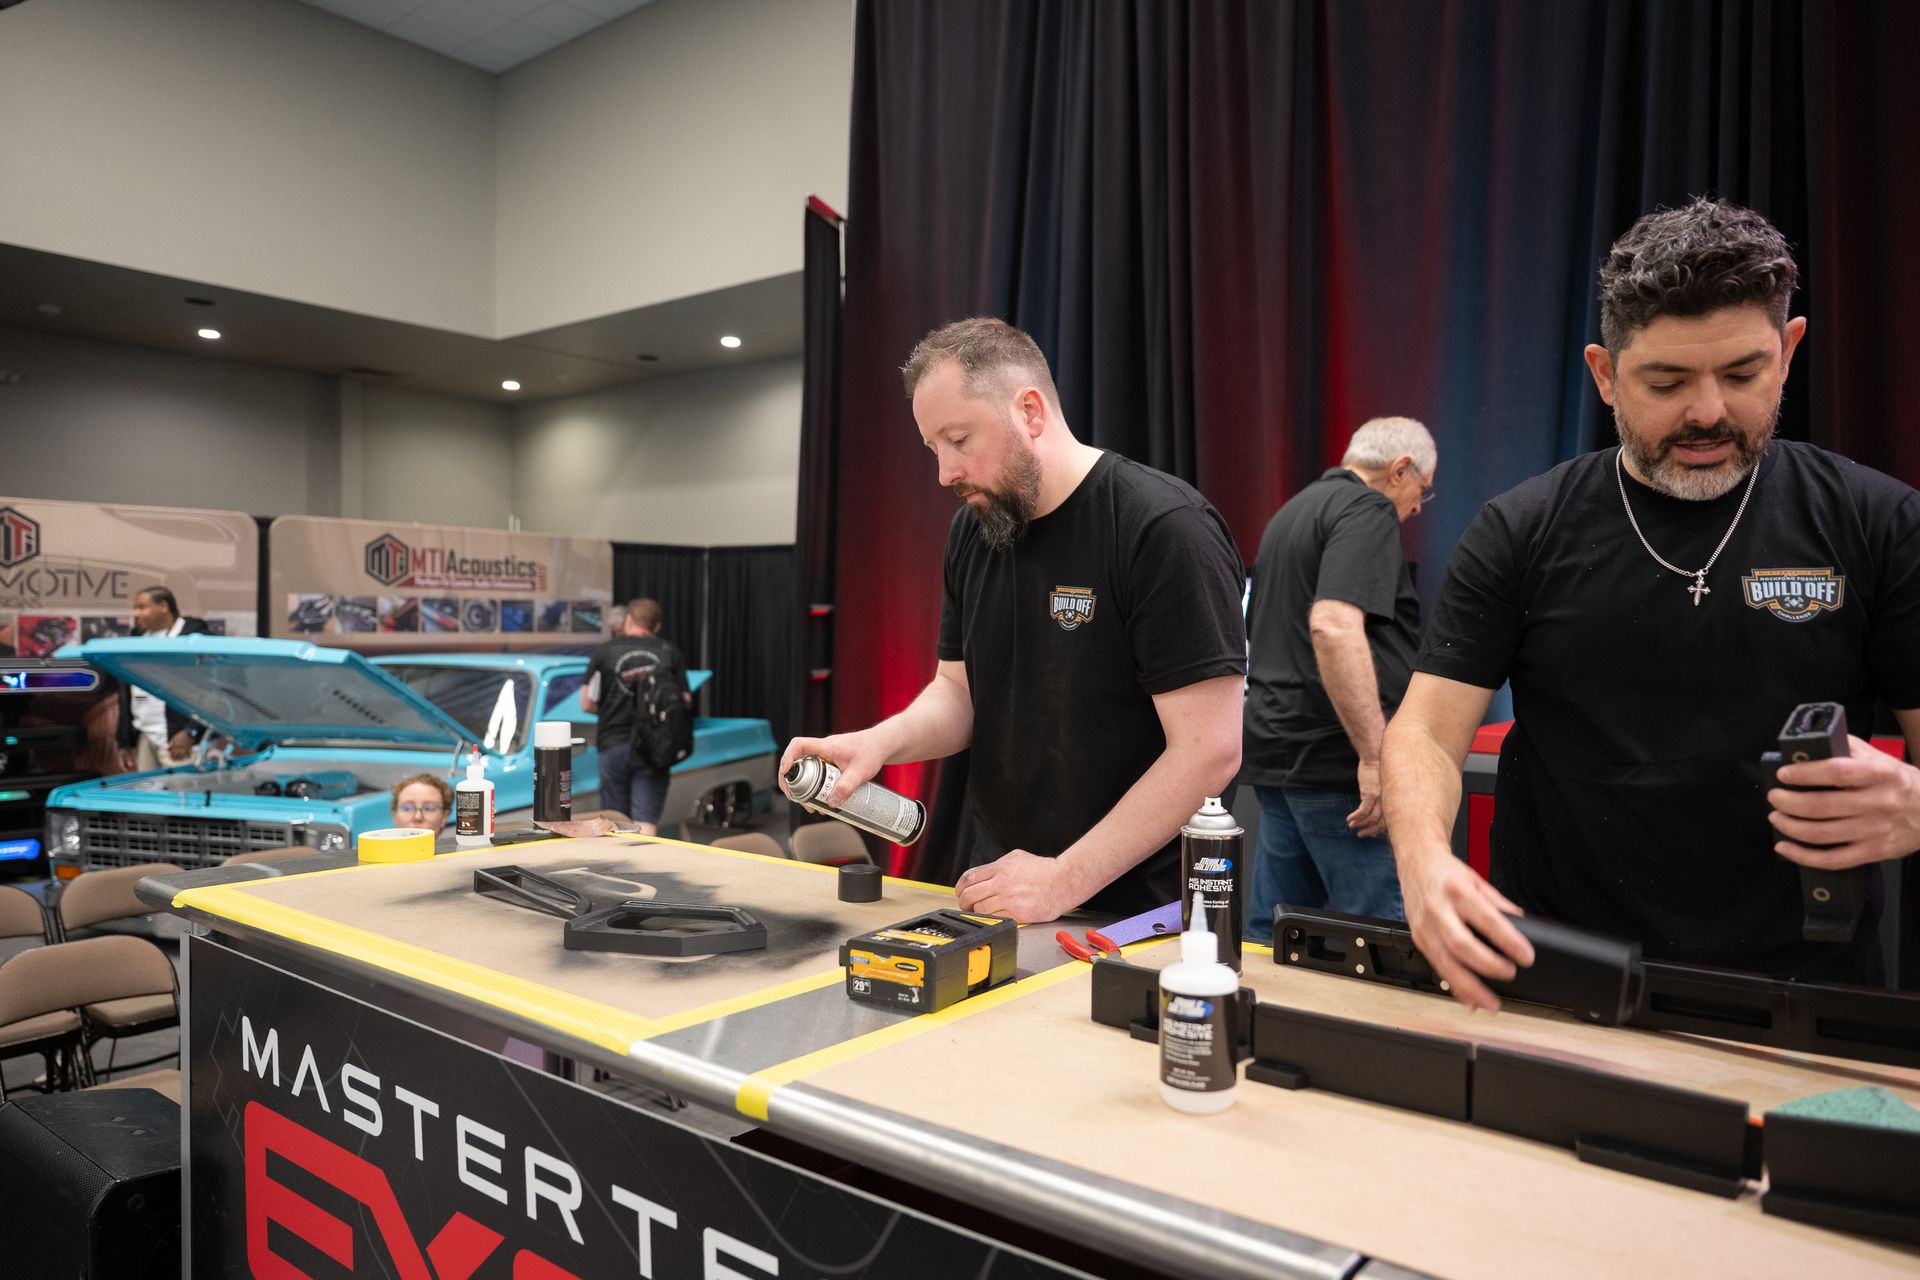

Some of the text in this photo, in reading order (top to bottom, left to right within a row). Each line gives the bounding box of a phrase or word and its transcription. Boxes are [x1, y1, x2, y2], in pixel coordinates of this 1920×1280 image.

[1750, 581, 1836, 602] BUILD OFF
[1053, 596, 1092, 616] BUILD OFF
[1188, 883, 1233, 892] ADHESIVE
[854, 980, 865, 991] 29
